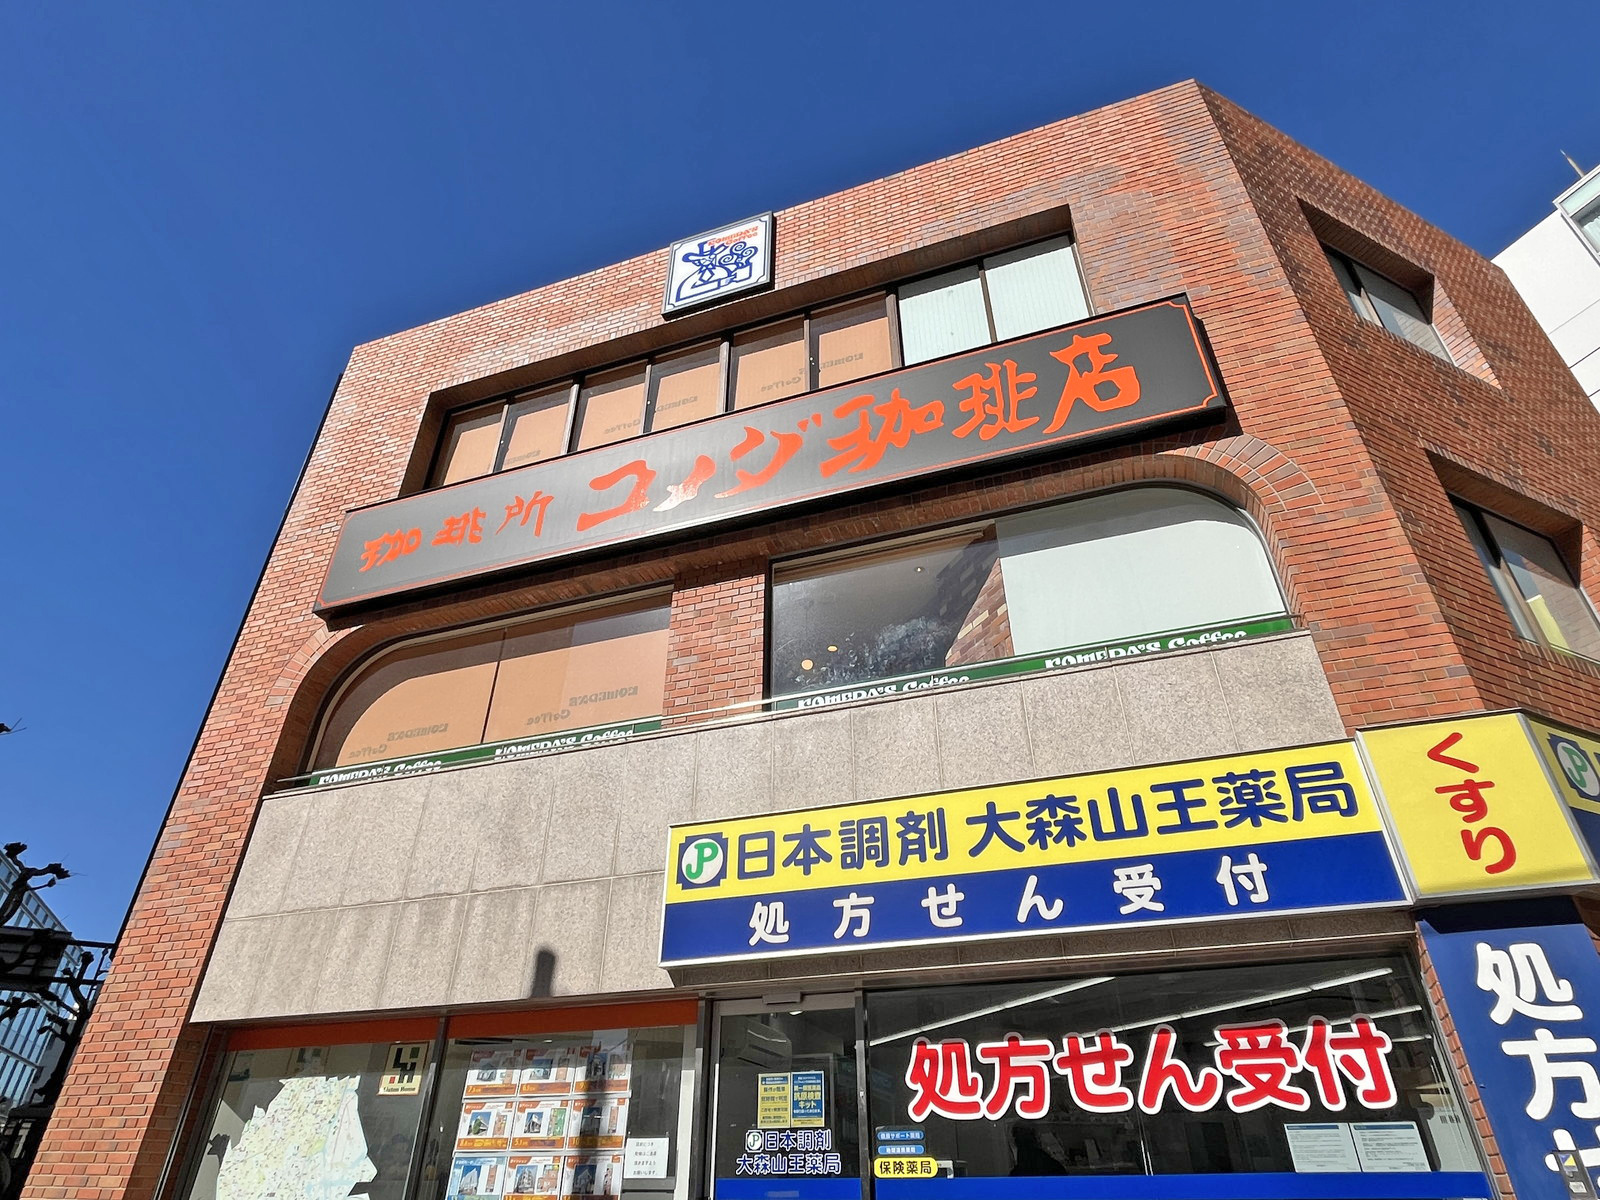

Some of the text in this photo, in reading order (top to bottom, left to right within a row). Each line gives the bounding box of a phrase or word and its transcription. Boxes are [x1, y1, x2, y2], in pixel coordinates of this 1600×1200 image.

[736, 806, 950, 881] 日本調剤
[966, 759, 1358, 858] 大森山王薬局
[1426, 732, 1517, 875] くすり
[748, 852, 1269, 947] 処方せん受付
[906, 1013, 1398, 1122] 処方せん受付
[798, 1101, 817, 1109] キット
[735, 1153, 842, 1175] 大森山王薬局
[765, 1129, 832, 1151] 日本調剤
[879, 1160, 932, 1175] 保険薬局
